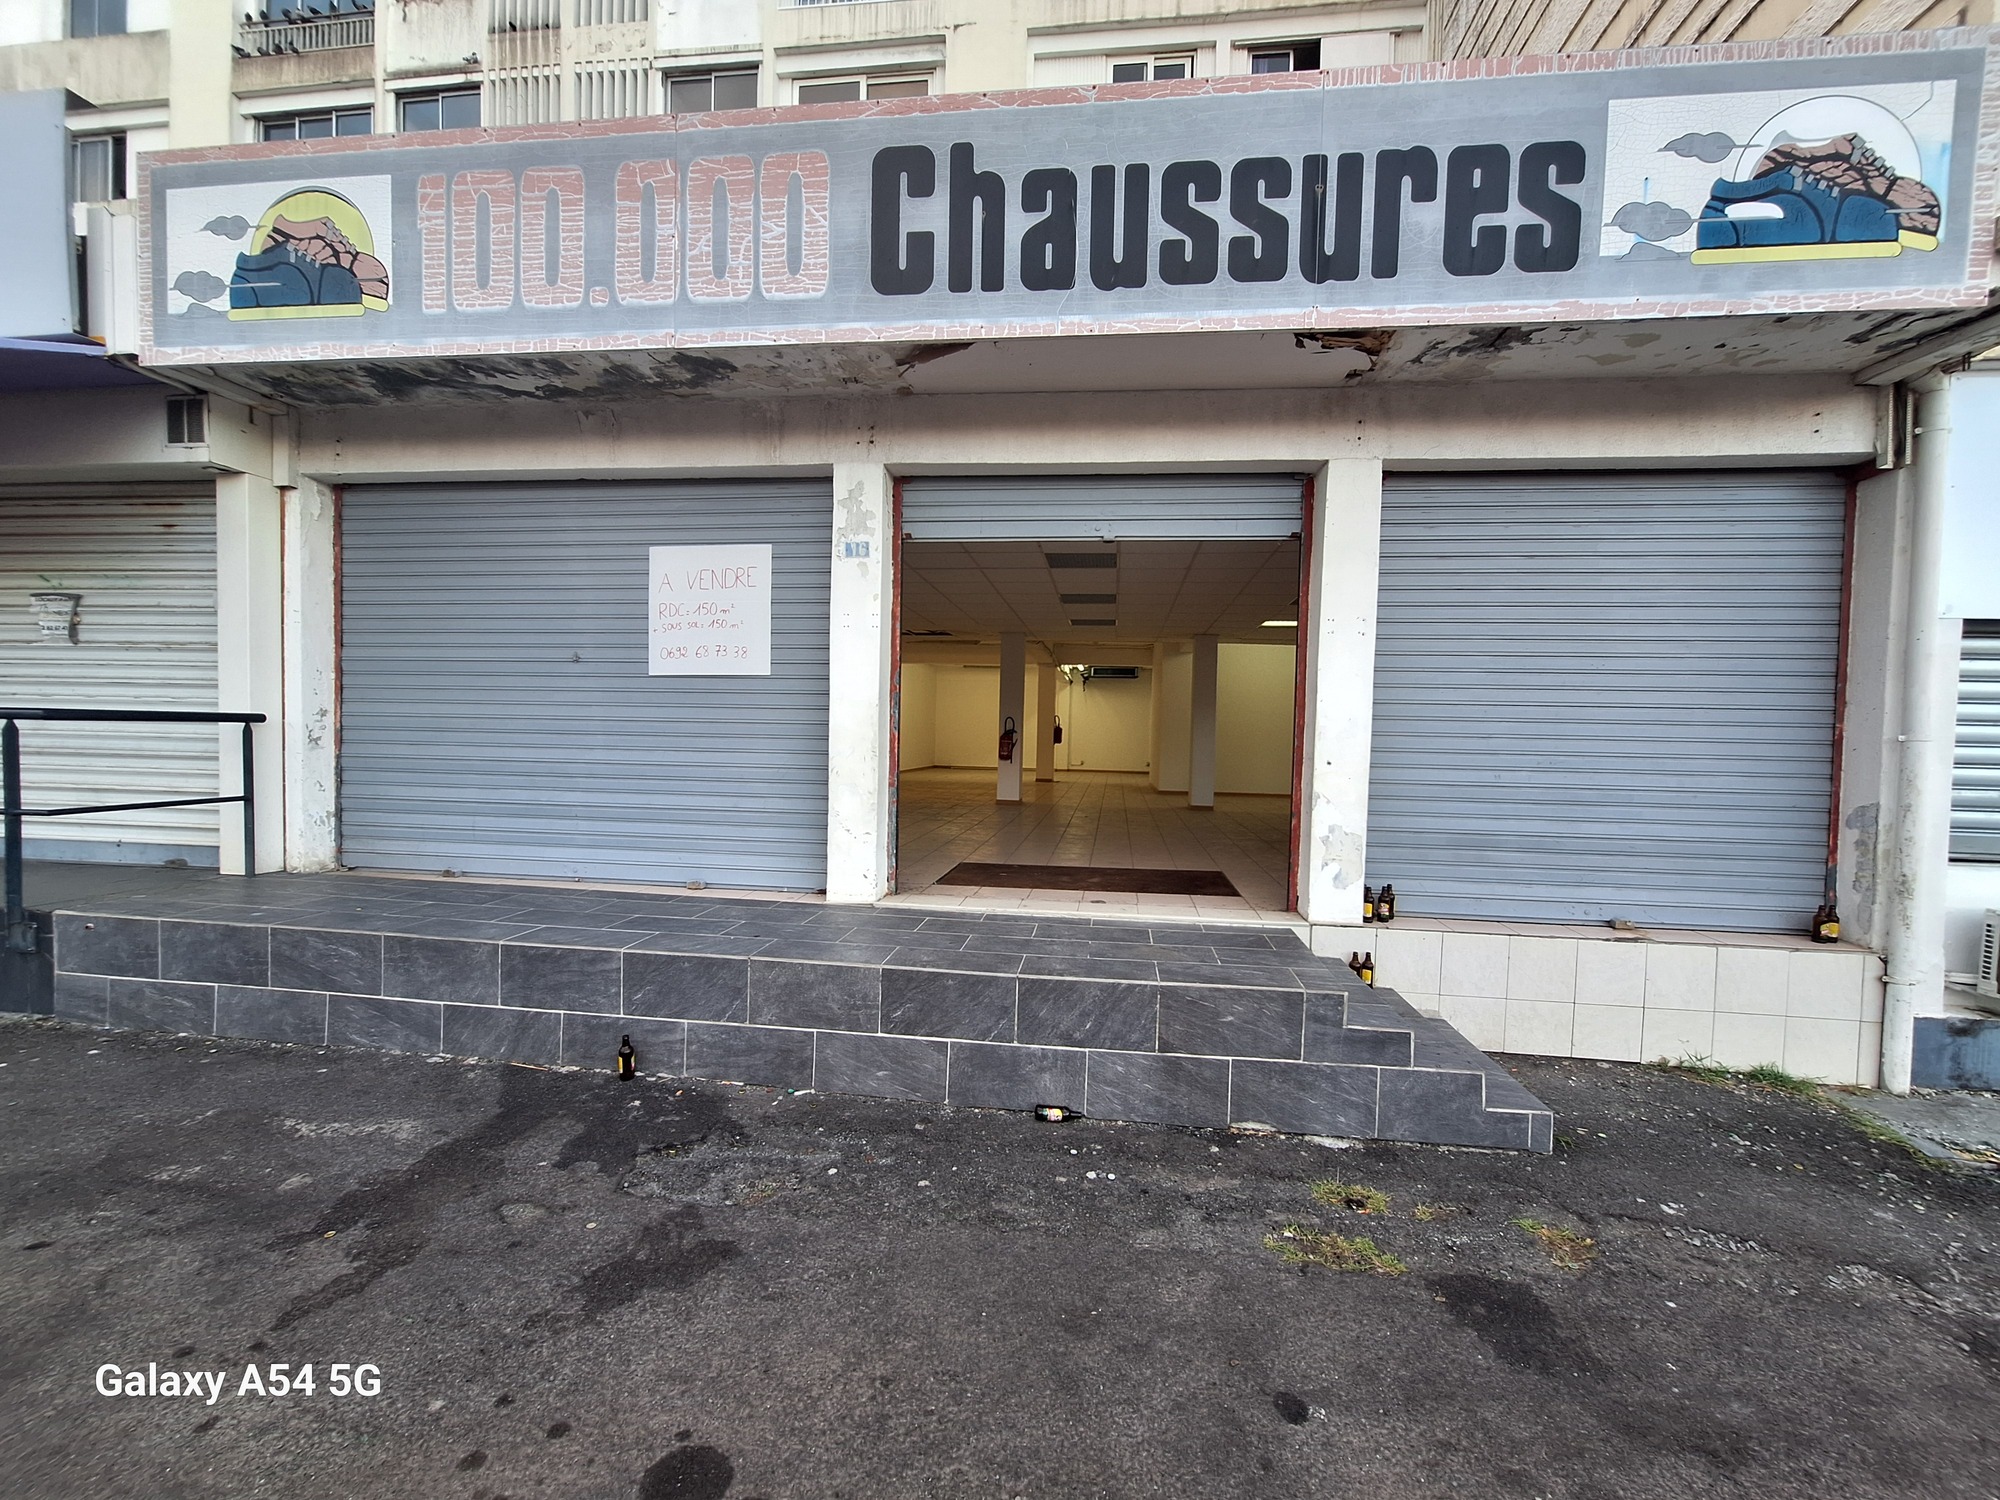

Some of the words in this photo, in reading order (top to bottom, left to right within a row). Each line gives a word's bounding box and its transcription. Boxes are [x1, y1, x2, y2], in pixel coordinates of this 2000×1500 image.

[418, 150, 830, 314] 100.000
[870, 140, 1587, 296] Chaussures
[658, 573, 674, 593] A
[686, 566, 758, 591] VENDRE
[692, 602, 718, 616] 150
[708, 618, 728, 629] 150
[660, 645, 688, 660] 0692
[695, 645, 709, 659] 68
[715, 644, 728, 657] 73
[733, 645, 748, 659] 38
